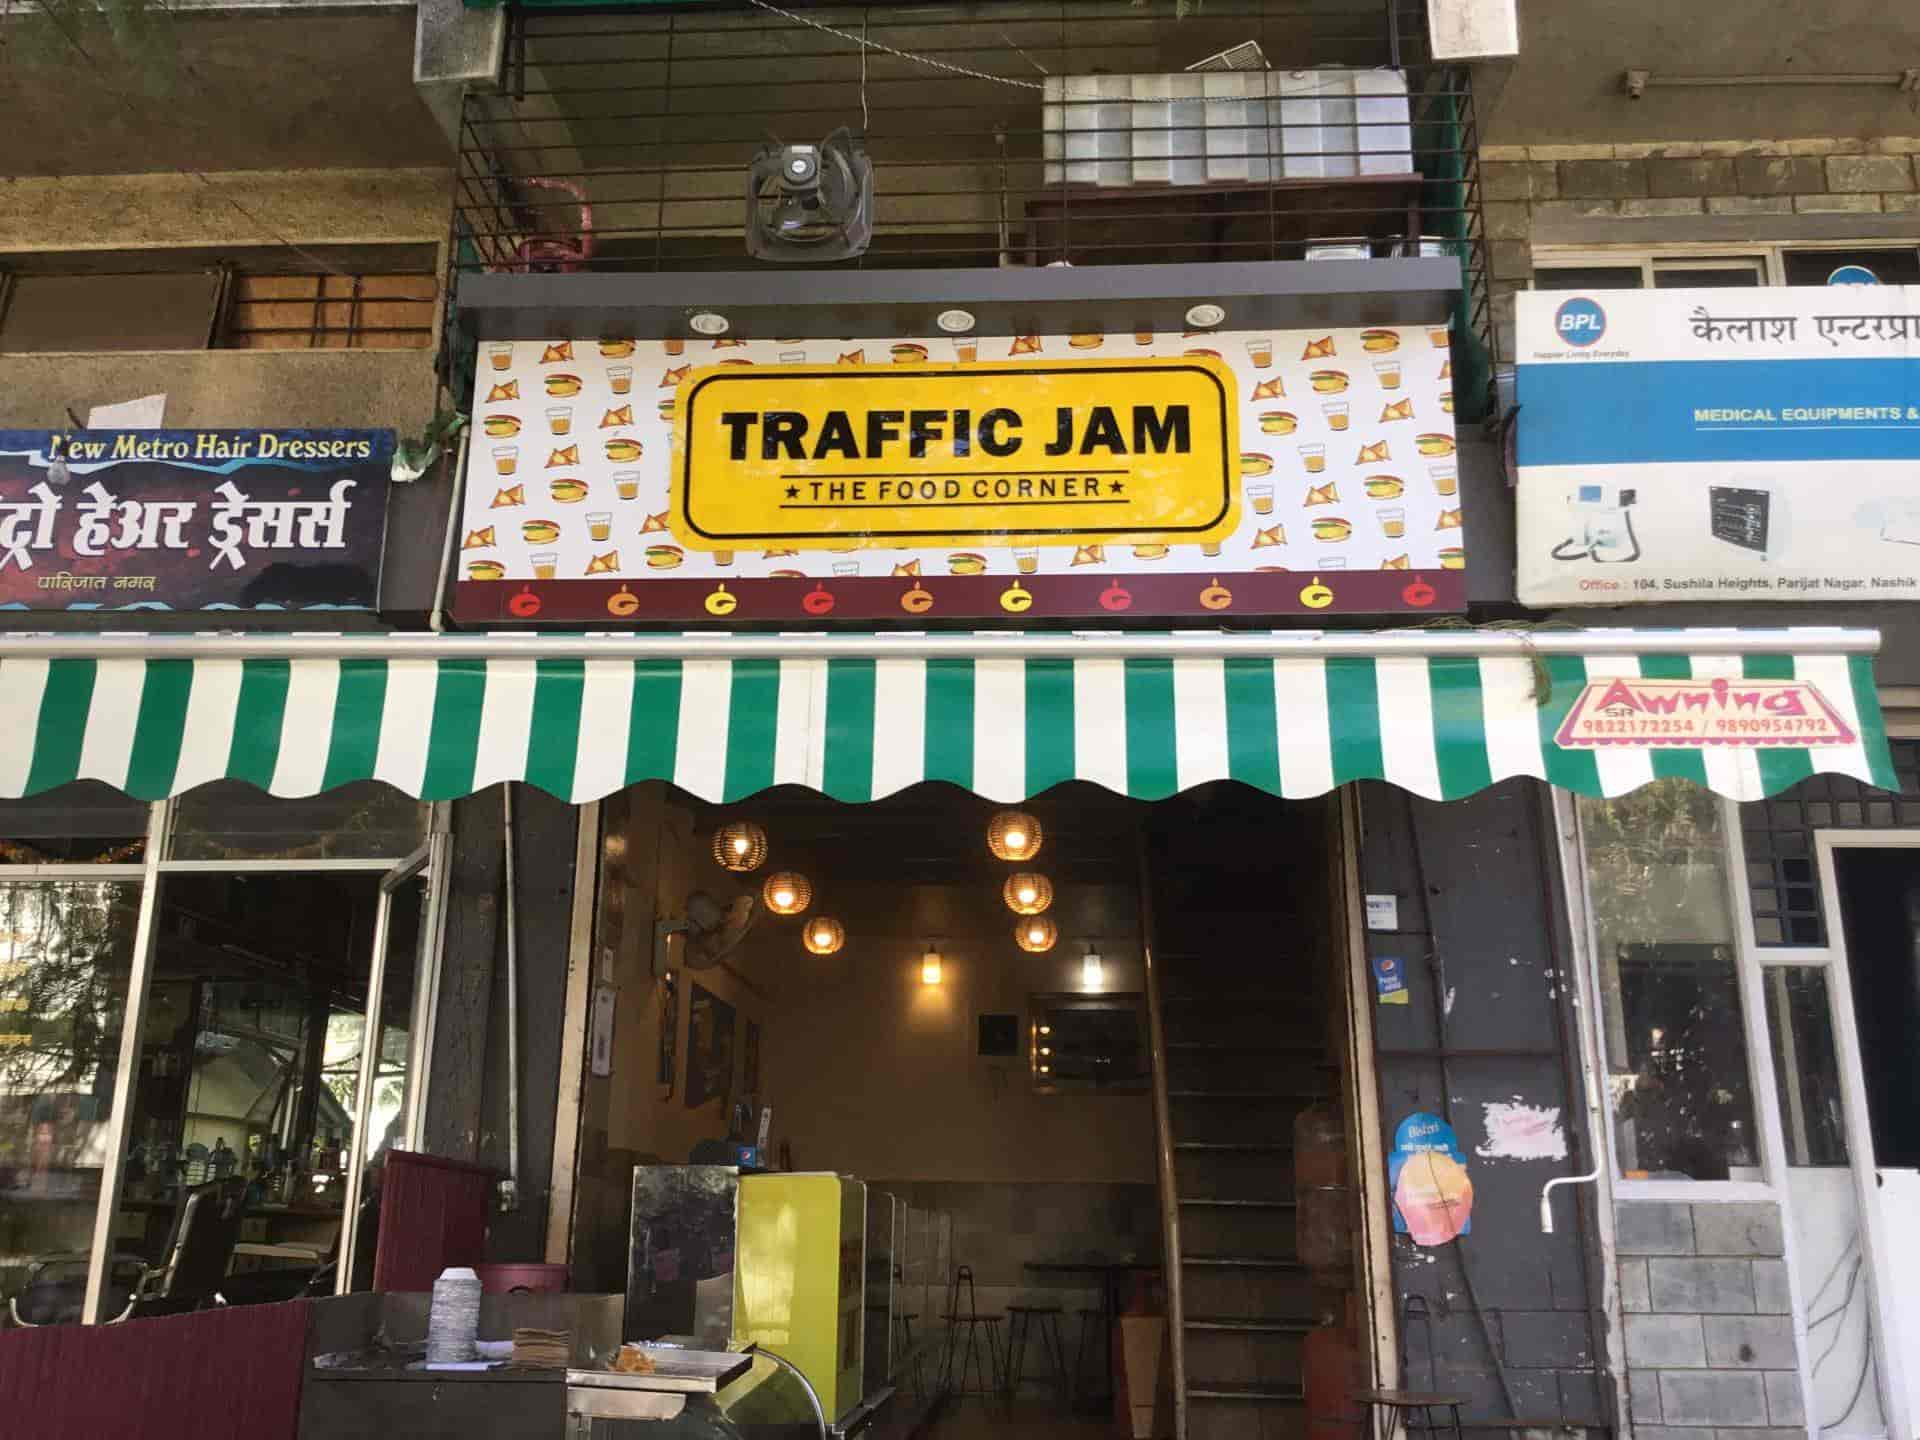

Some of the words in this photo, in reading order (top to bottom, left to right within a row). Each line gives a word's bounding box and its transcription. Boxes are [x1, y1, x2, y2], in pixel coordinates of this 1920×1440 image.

[1560, 313, 1601, 331] BPL
[1689, 305, 1798, 344] कैलाश
[1694, 408, 1777, 421] MEDICAL
[1781, 407, 1901, 420] EQUIPMENTS
[721, 407, 1023, 461] TRAFFIC
[1044, 405, 1191, 456] JAM
[110, 435, 189, 459] Metro
[194, 434, 252, 459] Hair
[257, 434, 371, 459] Dressers
[809, 481, 867, 500] THE
[878, 479, 961, 499] FOOD
[973, 477, 1101, 498] CORNER
[72, 481, 198, 556] हेअर
[208, 480, 358, 570] ड्रेसर्स
[1579, 579, 1619, 591] Office
[1663, 577, 1714, 590] Sushila
[1871, 576, 1917, 589] Nashik
[1594, 678, 1807, 716] Awning
[1716, 718, 1827, 732] 9890954792
